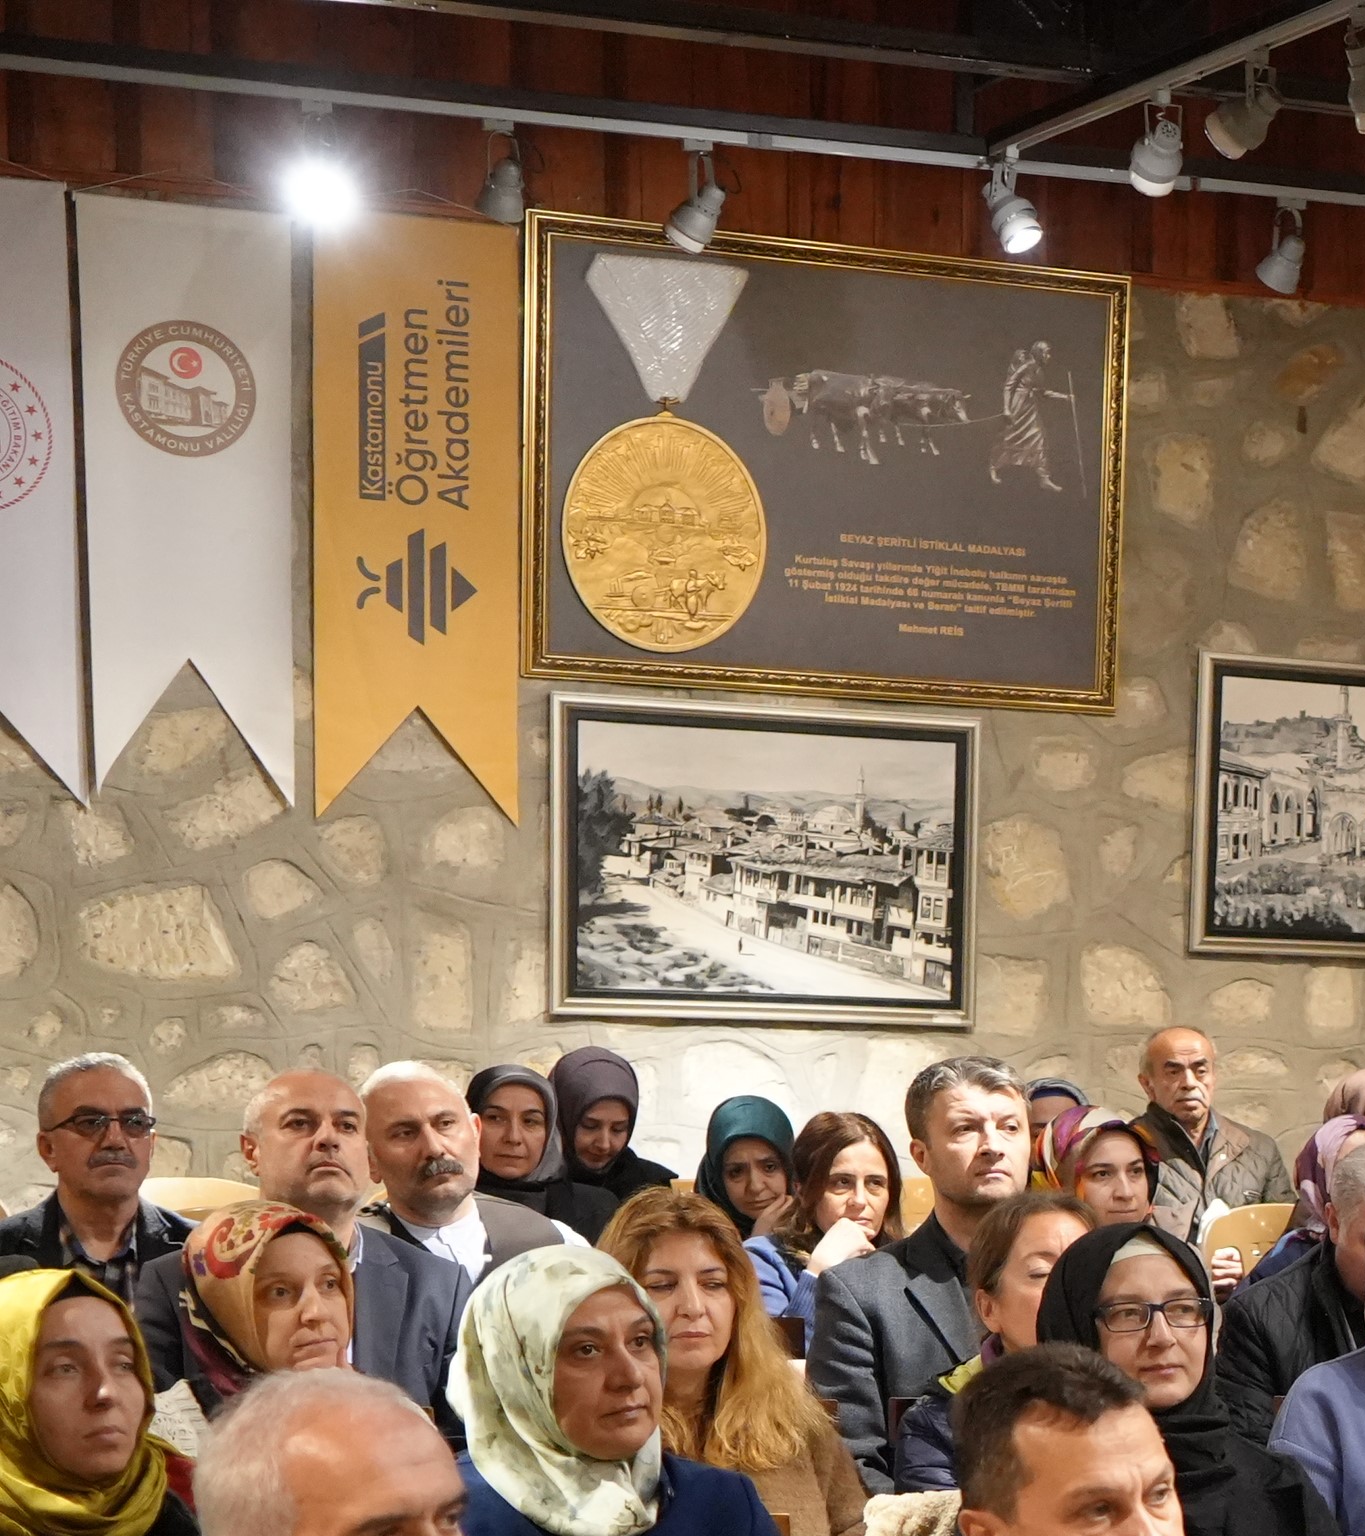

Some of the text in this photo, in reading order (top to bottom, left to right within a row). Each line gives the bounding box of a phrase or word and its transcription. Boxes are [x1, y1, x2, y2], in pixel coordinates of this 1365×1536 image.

[121, 326, 252, 392] TÜRKİYE CUMHURİYETİ
[0, 393, 22, 431] ĞİTİM
[122, 392, 201, 452] KASTAMONU
[387, 308, 438, 506] Öğretmen
[437, 279, 470, 511] Akademileri
[361, 361, 383, 495] Kastamonu
[840, 533, 875, 545] BEYAZ
[788, 578, 799, 588] 11
[834, 582, 857, 592] 1924
[939, 625, 964, 637] REİS
